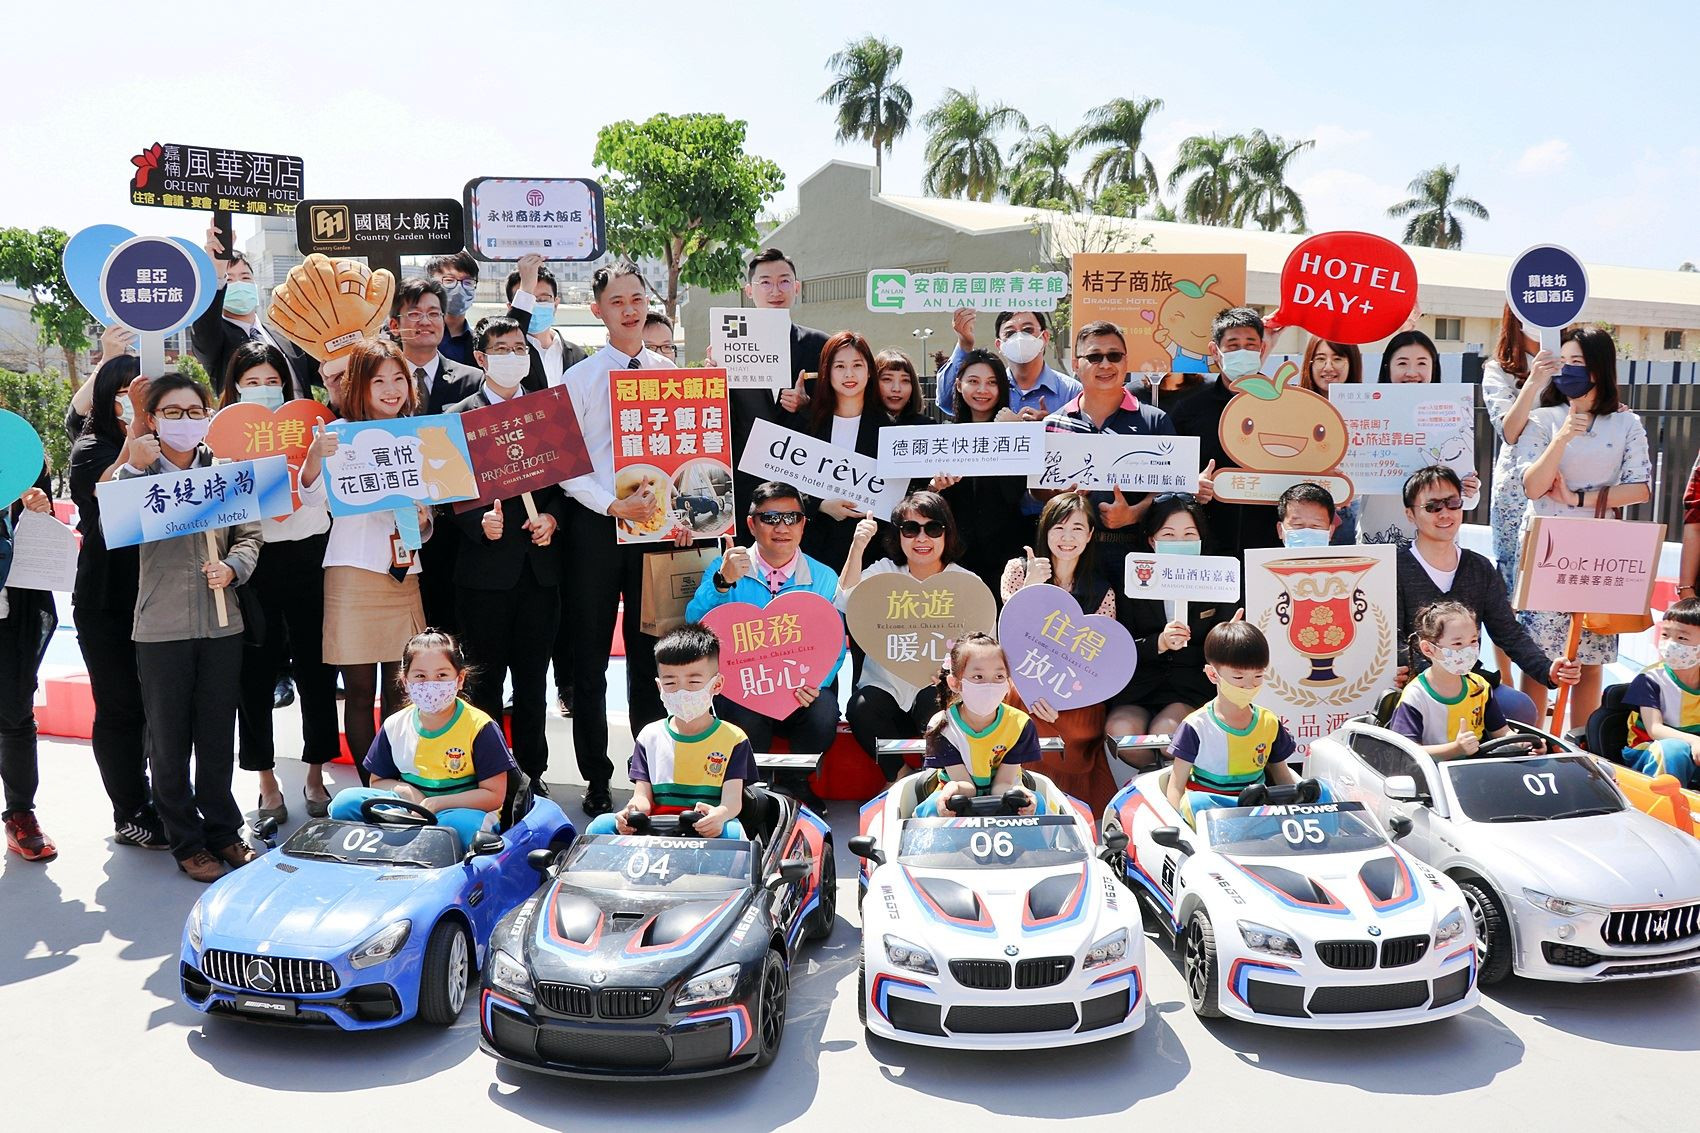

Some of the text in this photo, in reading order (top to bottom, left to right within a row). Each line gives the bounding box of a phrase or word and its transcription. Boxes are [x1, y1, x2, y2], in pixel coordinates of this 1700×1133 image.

[185, 147, 302, 189] 風華酒店
[164, 179, 302, 201] ORIENT LUXURY HOTEL
[354, 212, 449, 231] 國園大飯店
[355, 232, 451, 242] Country Garden Hotel
[136, 268, 168, 284] 里亞
[1081, 270, 1174, 293] 桔子商旅
[1300, 252, 1406, 294] HOTEL
[1528, 274, 1567, 288] 蘭桂坊
[120, 287, 184, 304] 環島行旅
[914, 276, 1064, 294] 安蘭居國際青年館
[923, 297, 1053, 307] AN LAN JIE Hostel
[1292, 283, 1374, 315] DAY+
[1522, 289, 1574, 304] 花園酒店
[724, 342, 760, 352] HOTEL
[724, 354, 779, 364] DISCOVER
[619, 406, 724, 432] 親子飯店
[243, 419, 307, 453] 消費
[494, 428, 526, 447] NICE
[621, 430, 725, 457] 寵物友善
[892, 435, 1031, 457] 德爾芙快捷酒店
[1347, 432, 1427, 446] 心旅遊靠自己
[480, 449, 560, 483] PRINCE HOTEL
[769, 436, 886, 494] de rêve
[952, 456, 980, 464] express
[337, 468, 419, 495] 花園酒店
[764, 462, 799, 480] express
[801, 474, 825, 489] hotel
[1231, 475, 1262, 491] 桔子
[143, 470, 255, 515] 香緹時尚
[165, 508, 249, 535] Shantis Motel
[1161, 567, 1236, 583] 兆品酒店嘉義
[1593, 558, 1647, 574] HOTEL
[1556, 573, 1625, 587] 嘉義樂客商旅
[886, 589, 956, 620] 旅遊
[731, 613, 802, 655] 服務
[920, 622, 945, 630] Chiayi
[1040, 609, 1107, 663] 住得
[886, 632, 951, 663] 暖心
[1023, 631, 1050, 650] Welcome
[726, 656, 756, 667] Welcome
[770, 649, 795, 660] Chiayi
[797, 644, 816, 655] City
[739, 659, 806, 699] 貼心
[1015, 647, 1077, 700] 放心
[1522, 772, 1559, 796] 07
[1290, 803, 1339, 815] Power
[984, 817, 1040, 828] Power
[1281, 818, 1326, 844] 05
[342, 828, 384, 854] 02
[648, 838, 708, 849] Power
[970, 831, 1014, 857] 06
[627, 851, 670, 880] 04
[257, 1002, 286, 1011] AMG
